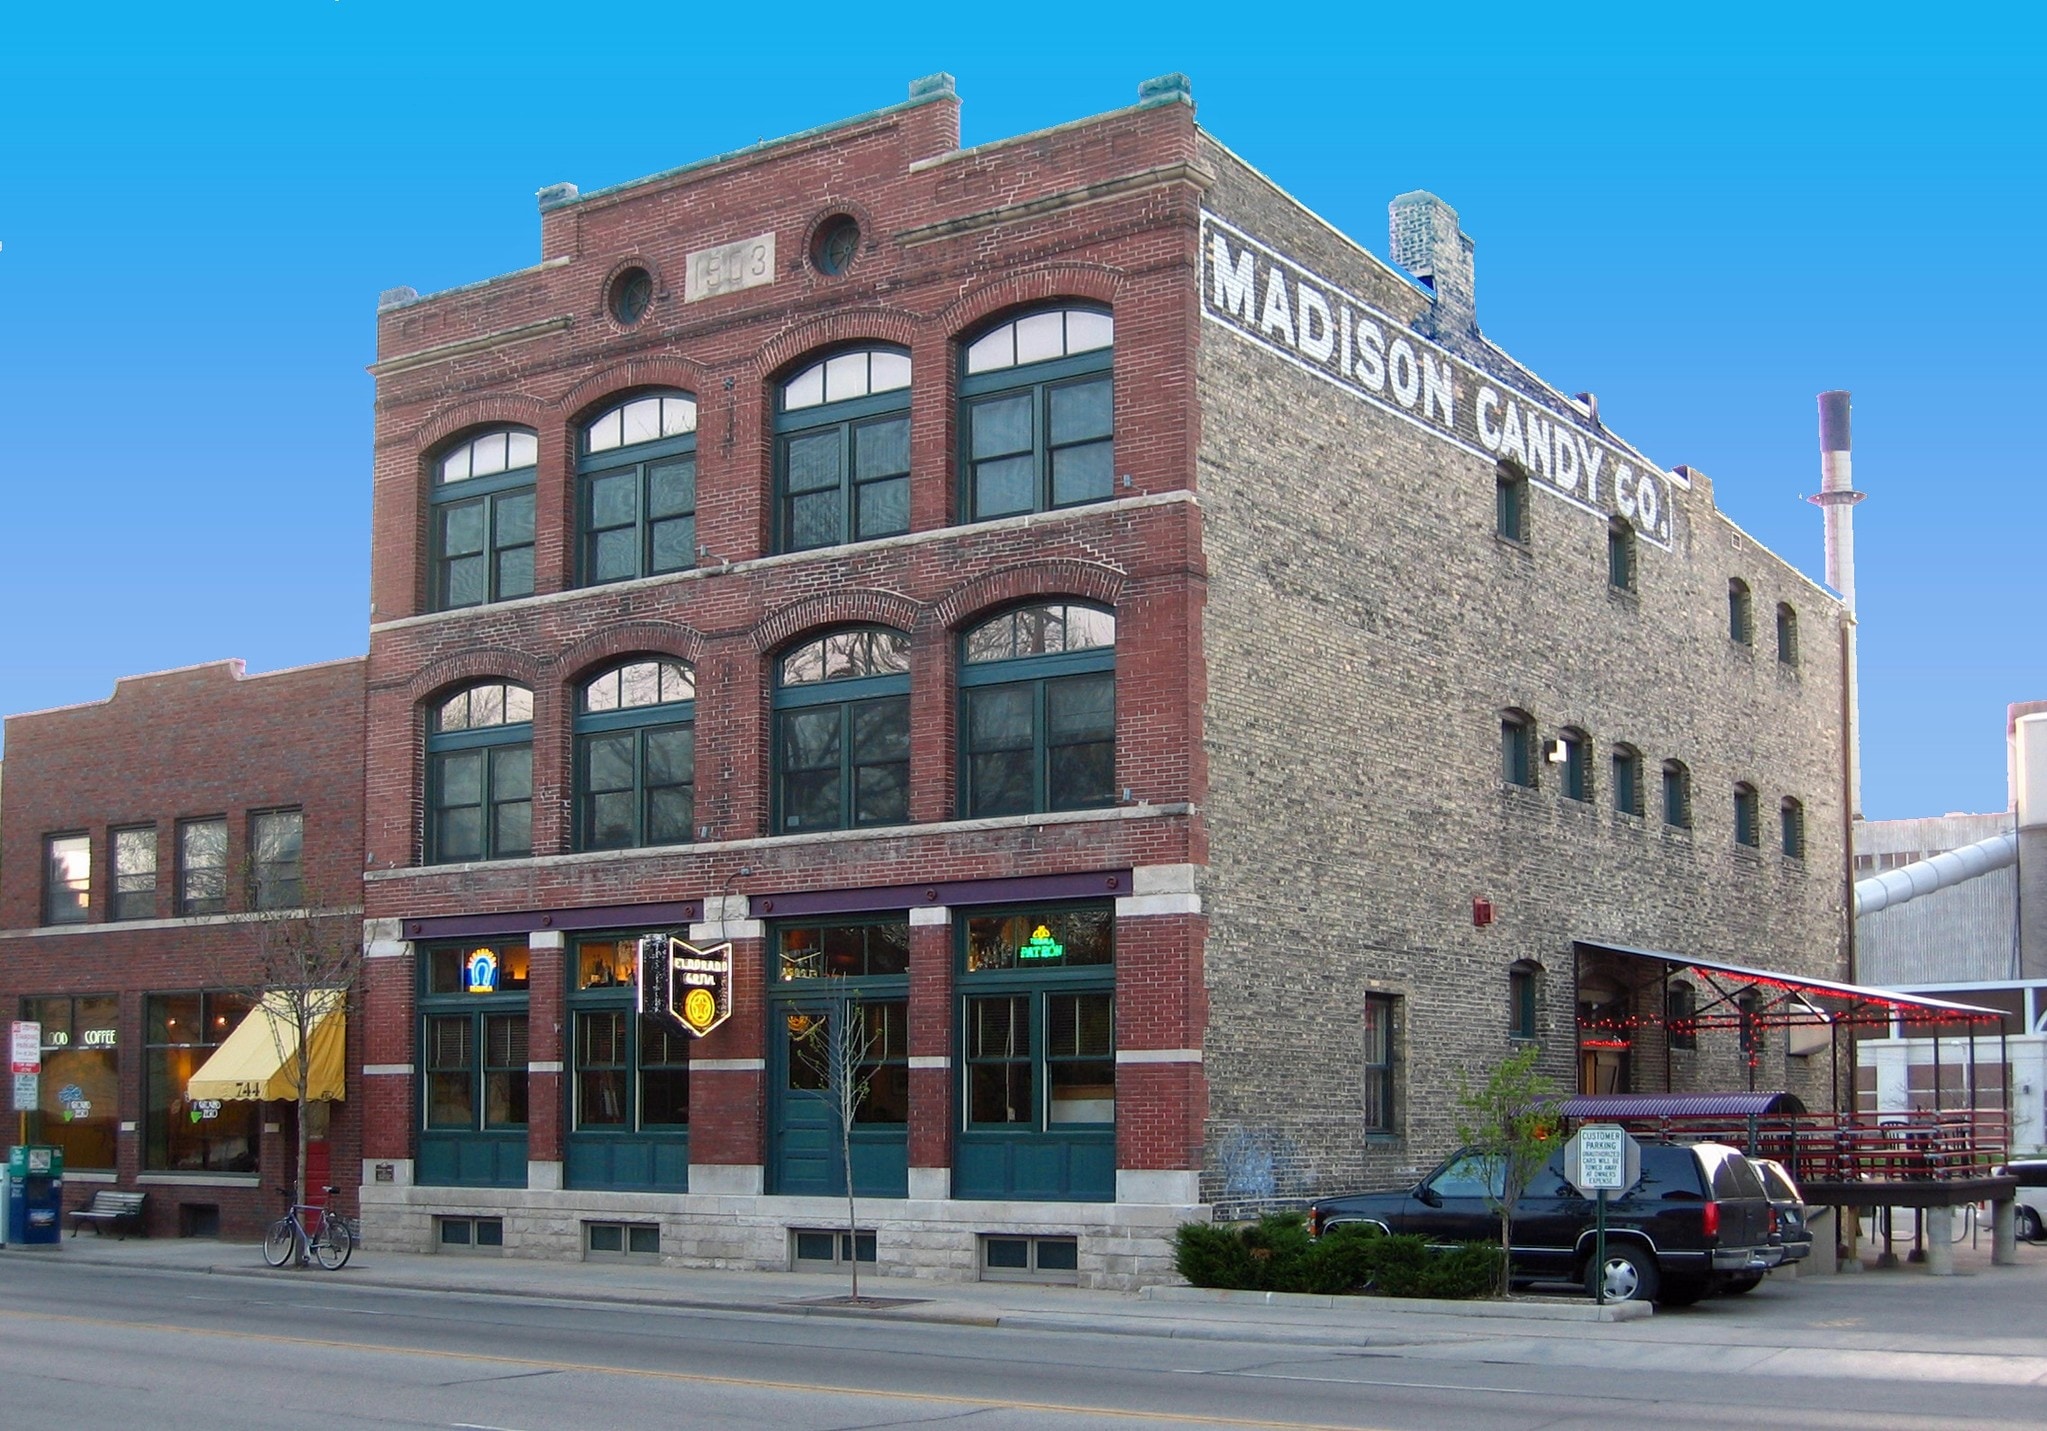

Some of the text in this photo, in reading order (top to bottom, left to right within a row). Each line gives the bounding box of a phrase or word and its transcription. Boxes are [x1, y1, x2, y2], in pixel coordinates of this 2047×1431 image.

[694, 245, 766, 291] 1903
[1213, 232, 1668, 539] MADISON CANDY CO.
[48, 1031, 68, 1045] OOD
[84, 1029, 116, 1044] COFFEE
[236, 1082, 261, 1097] 744
[1582, 1131, 1620, 1140] CUSTOMER
[1586, 1141, 1616, 1150] PARKING
